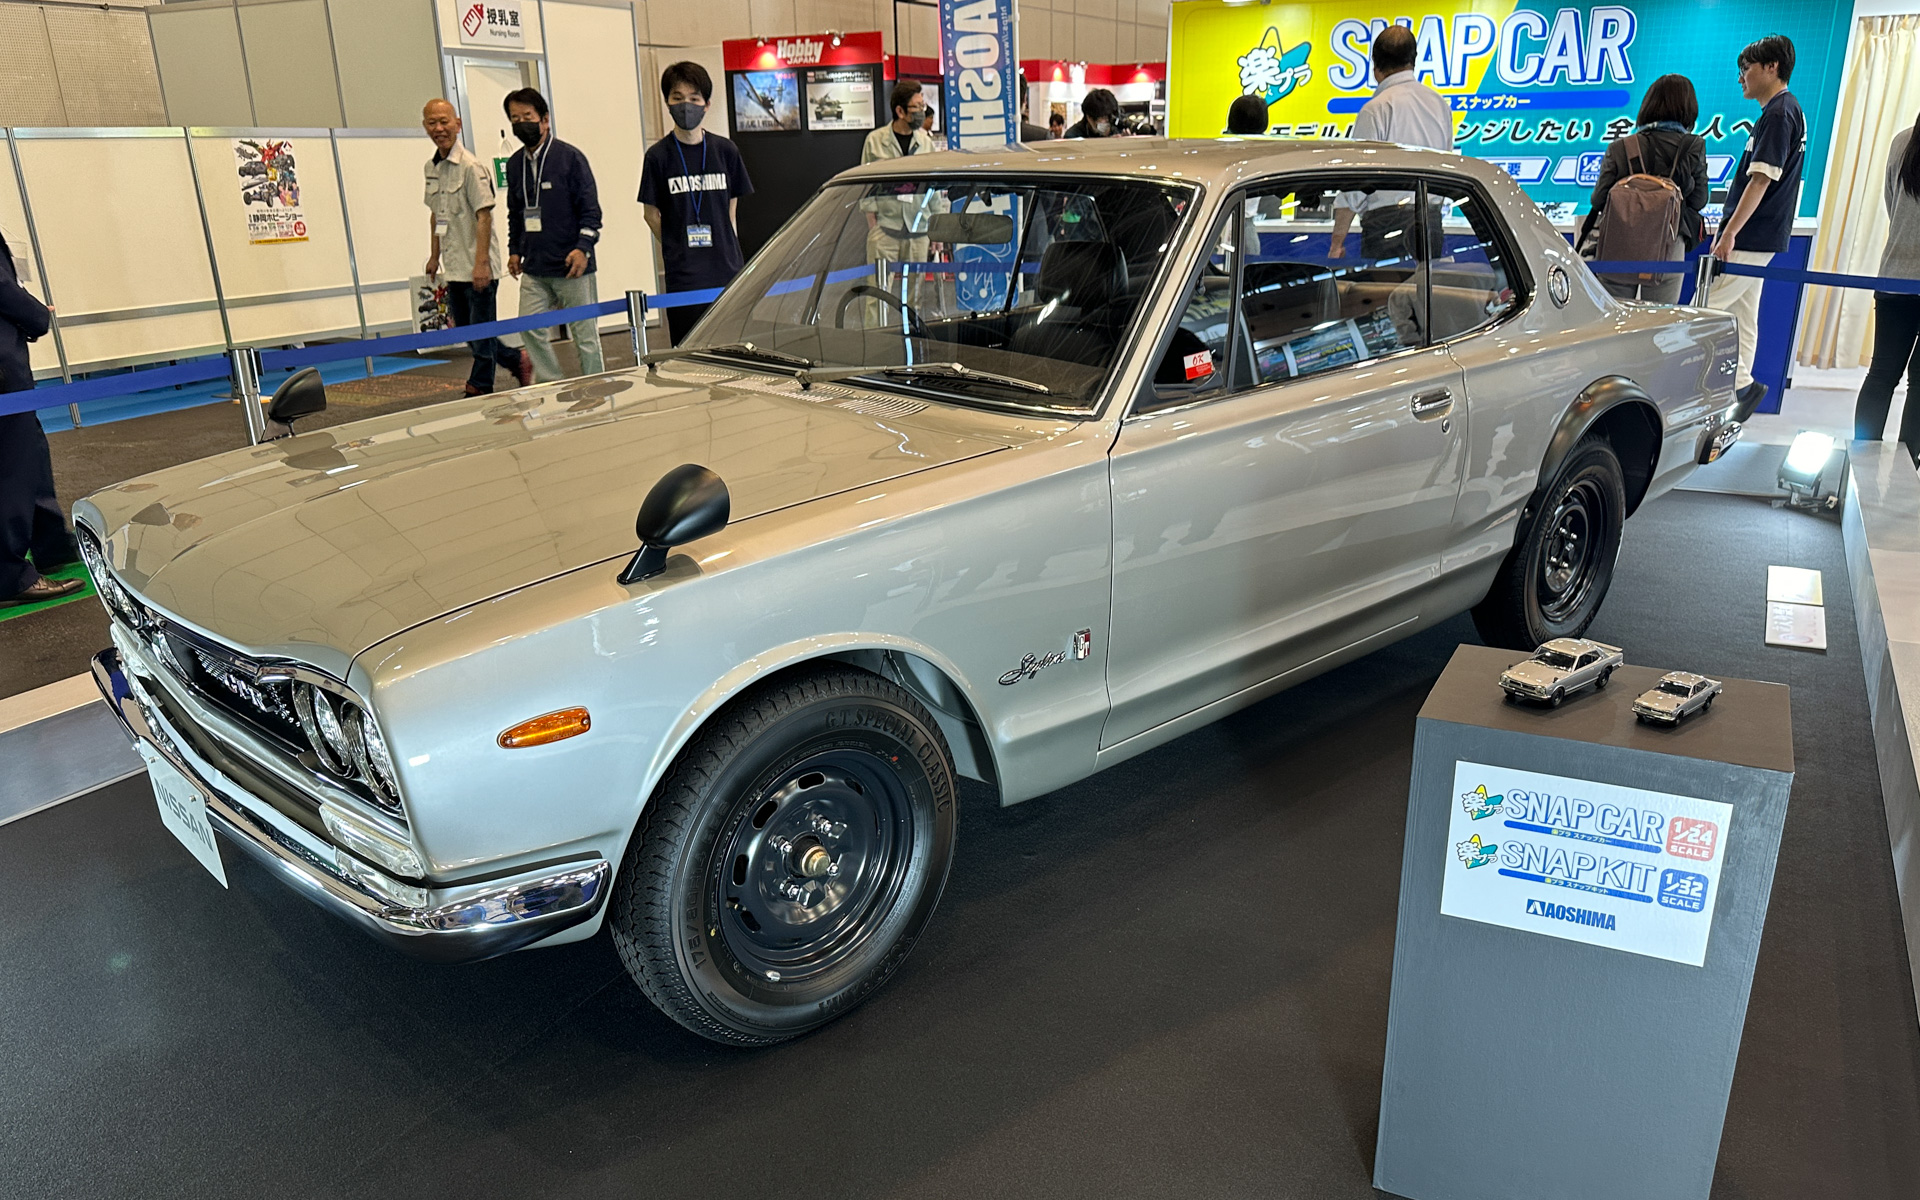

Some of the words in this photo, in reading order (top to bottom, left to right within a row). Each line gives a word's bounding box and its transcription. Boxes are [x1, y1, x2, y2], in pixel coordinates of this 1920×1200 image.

[486, 7, 520, 27] 授乳室
[489, 28, 507, 39] Nursing
[507, 30, 520, 38] Room
[776, 38, 824, 64] Hobby
[1497, 6, 1637, 86] CAR
[787, 57, 815, 65] JAPAN
[1237, 45, 1312, 96] 楽プラ
[1456, 94, 1531, 110] スナップカー
[1582, 155, 1602, 172] 1/2
[681, 172, 727, 193] AOSHIMA
[1580, 174, 1599, 182] SCAL
[1192, 353, 1205, 366] OK
[854, 707, 917, 747] SPECIAL
[916, 741, 951, 814] CLASSIC
[153, 776, 214, 852] NISSAN
[1461, 791, 1504, 815] 楽プラ
[1505, 788, 1595, 830] SNAP
[1594, 803, 1665, 844] CAR
[1573, 832, 1612, 844] スナップカー
[1673, 820, 1713, 846] 1/24
[1456, 840, 1498, 864] 楽プラ
[1670, 845, 1710, 858] SCALE
[1500, 840, 1596, 879] SNAP
[1596, 856, 1657, 893] KIT
[1663, 872, 1704, 898] 1/32
[1661, 895, 1700, 910] SCALE
[1544, 904, 1616, 931] AOSHIMA
